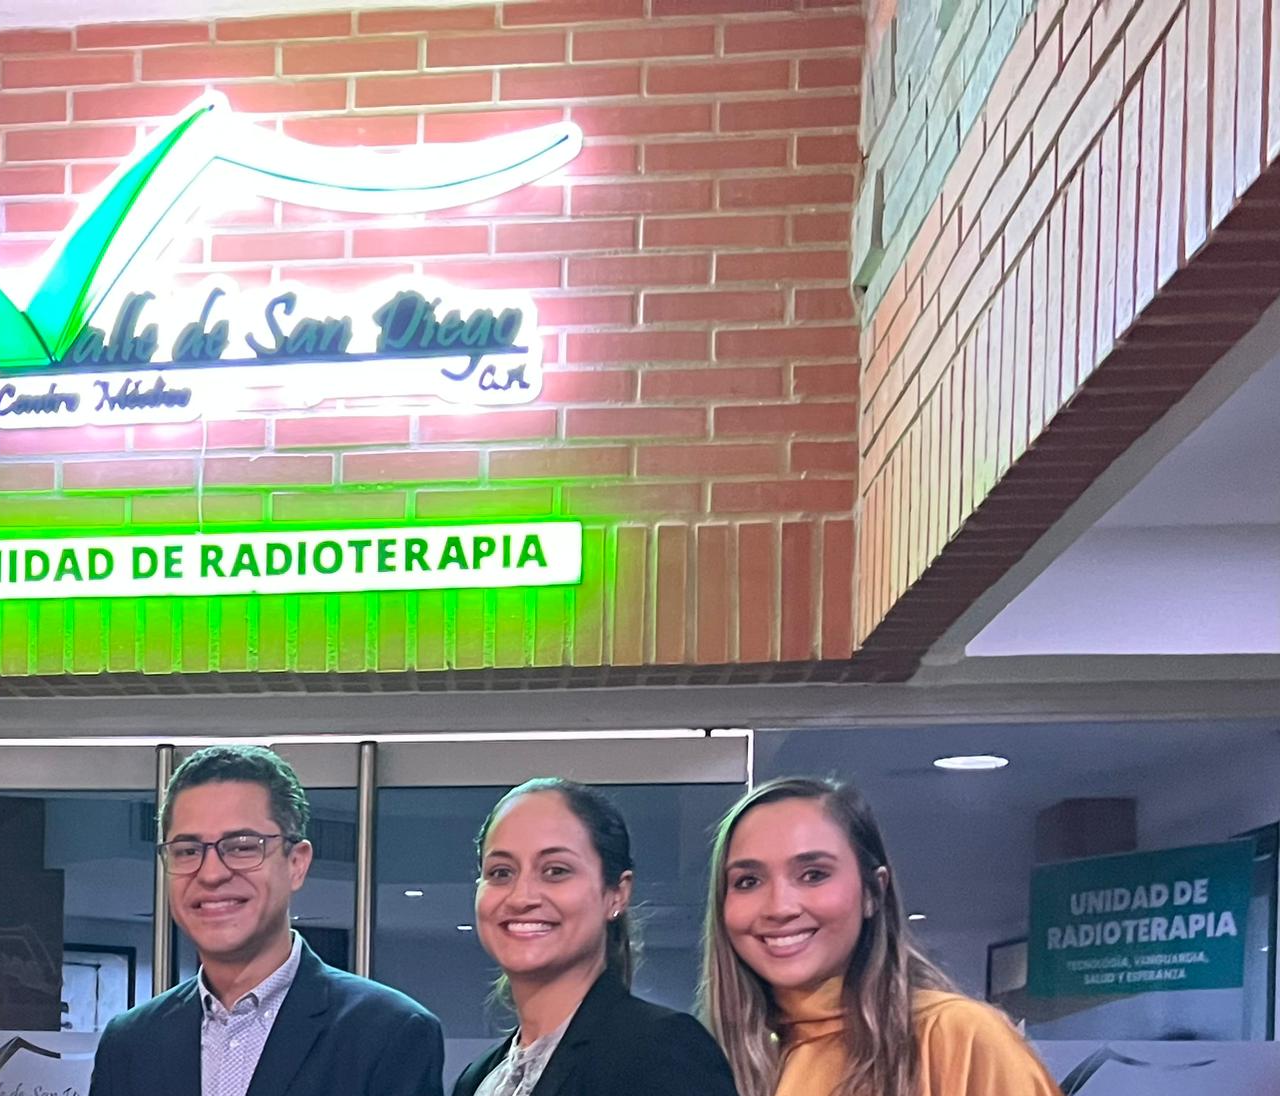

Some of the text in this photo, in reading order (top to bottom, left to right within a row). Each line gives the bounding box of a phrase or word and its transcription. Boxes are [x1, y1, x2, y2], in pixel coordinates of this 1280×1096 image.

[172, 288, 230, 362] de
[245, 291, 354, 357] San
[372, 290, 524, 382] Diego
[132, 544, 183, 579] DE
[199, 534, 548, 577] RADIOTERAPIA
[1070, 878, 1209, 916] UNIDAD DE
[1046, 911, 1238, 950] RADIOTERAPIA
[1084, 968, 1187, 984] SALUD Y ESPERANZA
